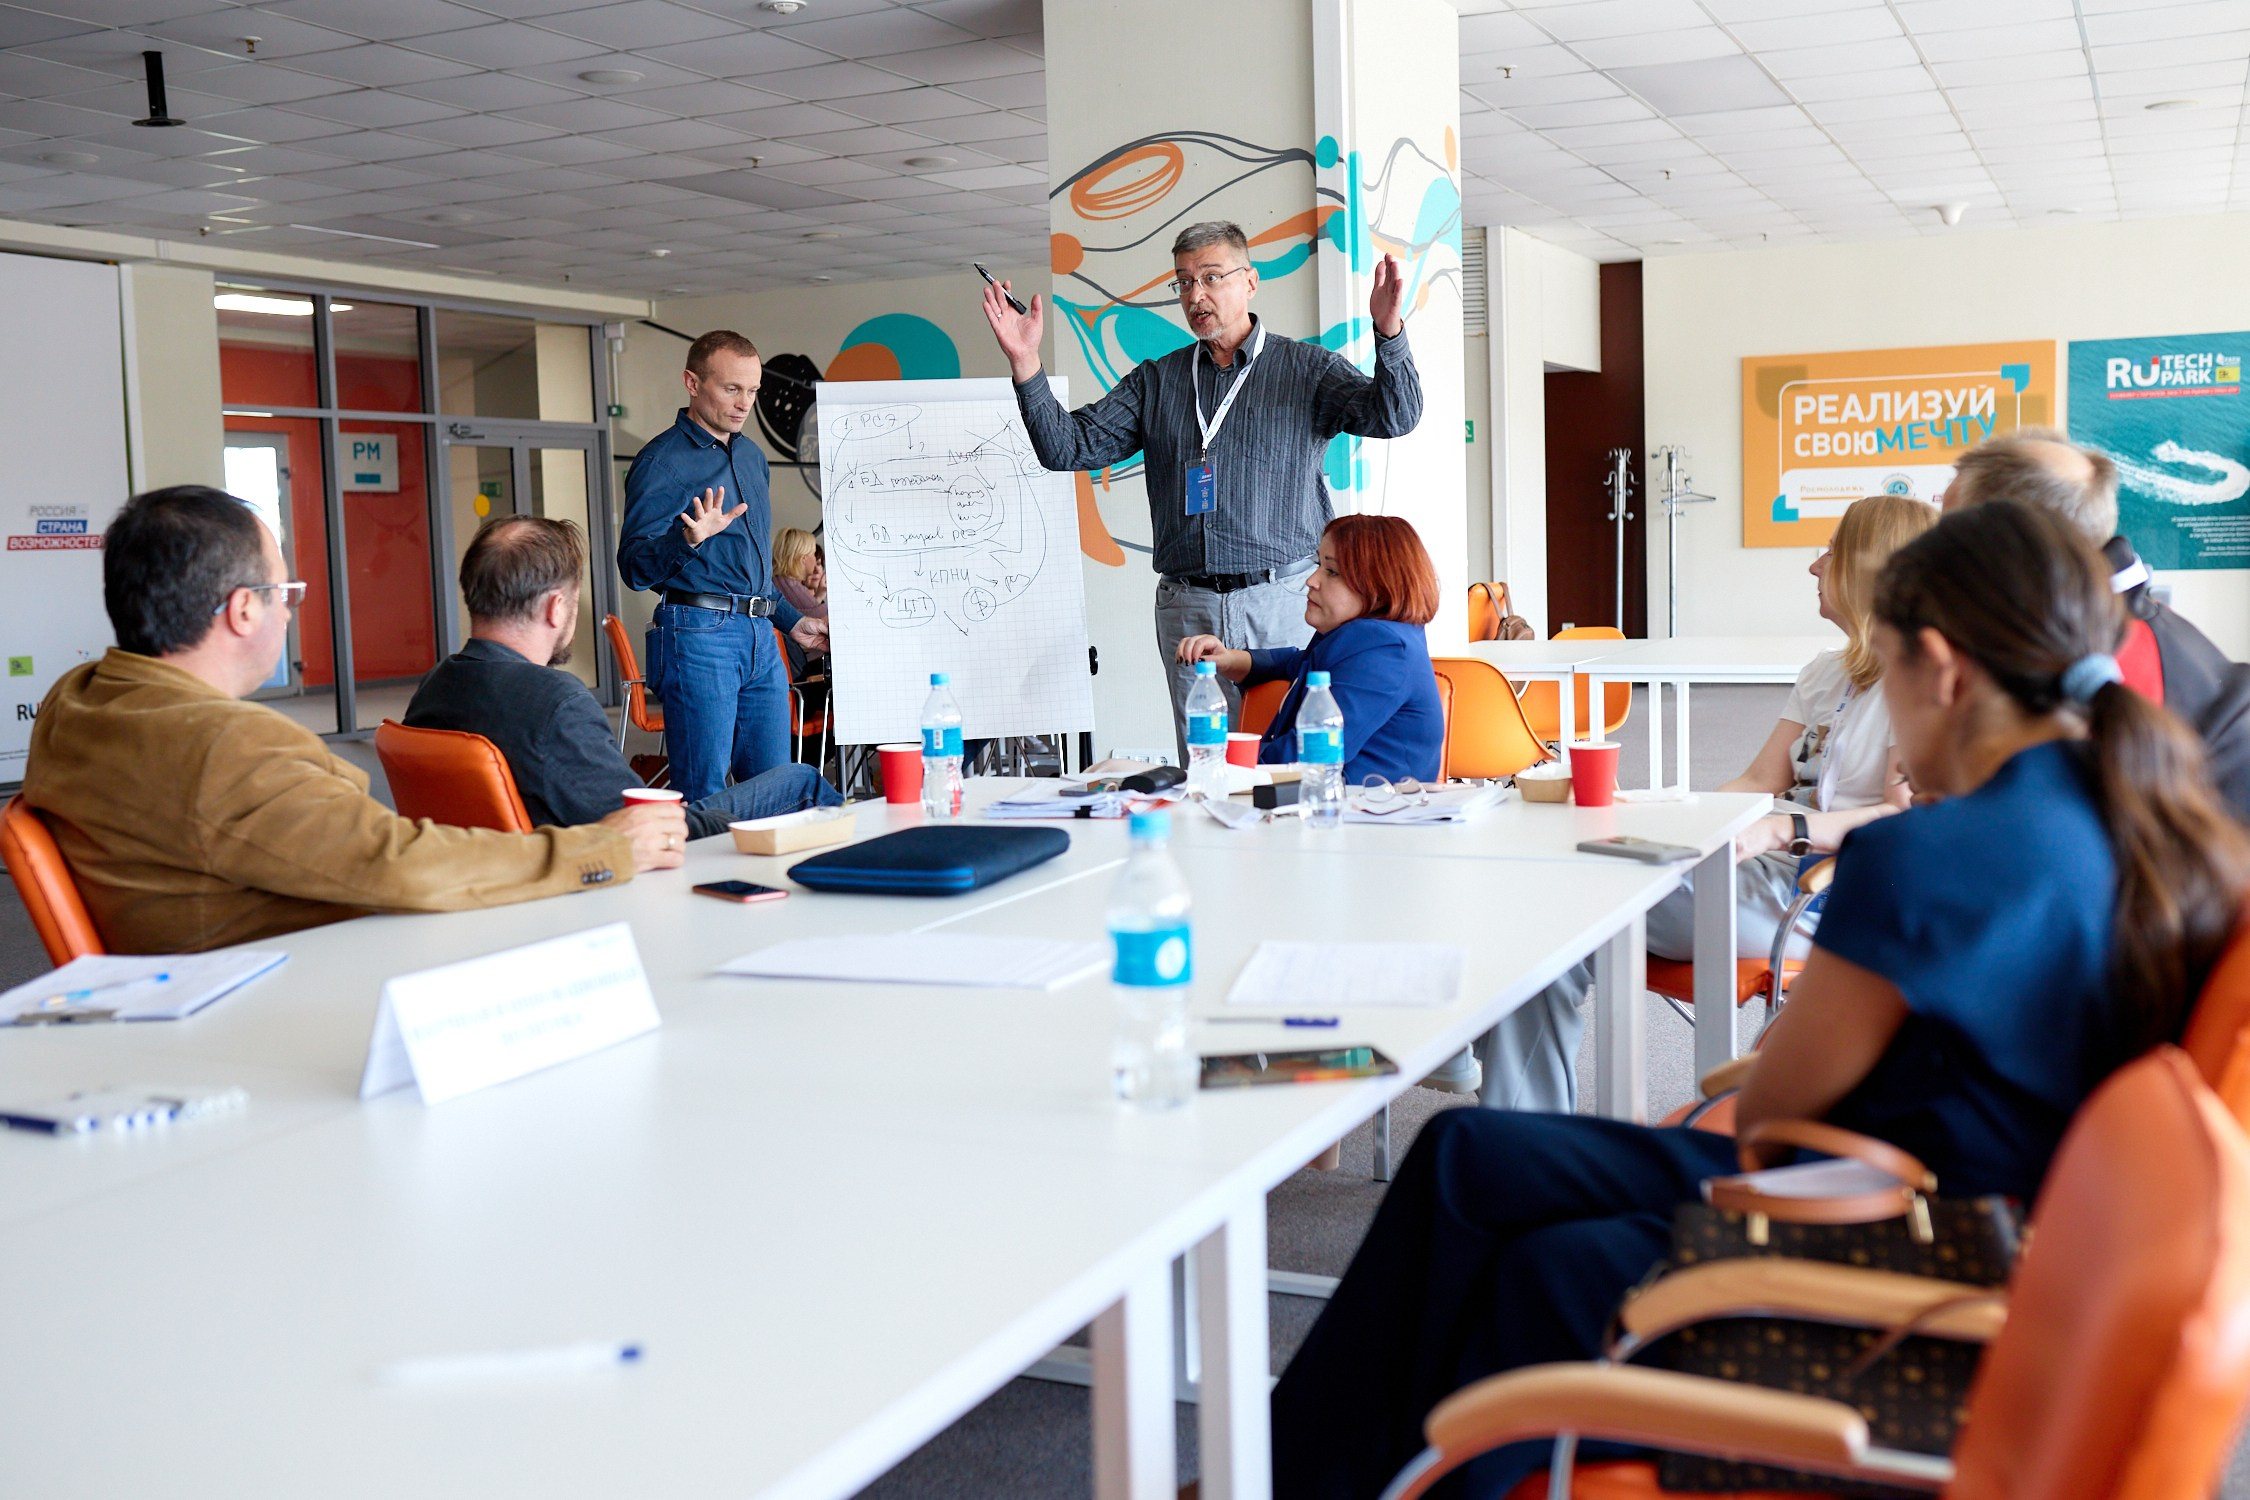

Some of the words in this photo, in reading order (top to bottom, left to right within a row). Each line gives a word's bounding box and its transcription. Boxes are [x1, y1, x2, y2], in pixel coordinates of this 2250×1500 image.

[2107, 355, 2160, 388] RU
[2161, 353, 2213, 370] TECH
[2161, 368, 2212, 386] PARK
[1794, 384, 1995, 425] РЕАЛИЗУЙ
[1794, 430, 1878, 457] СВОЮ
[1875, 412, 1997, 453] МЕЧТУ
[30, 505, 77, 516] РОССИЯ
[38, 521, 84, 533] СТРАНА
